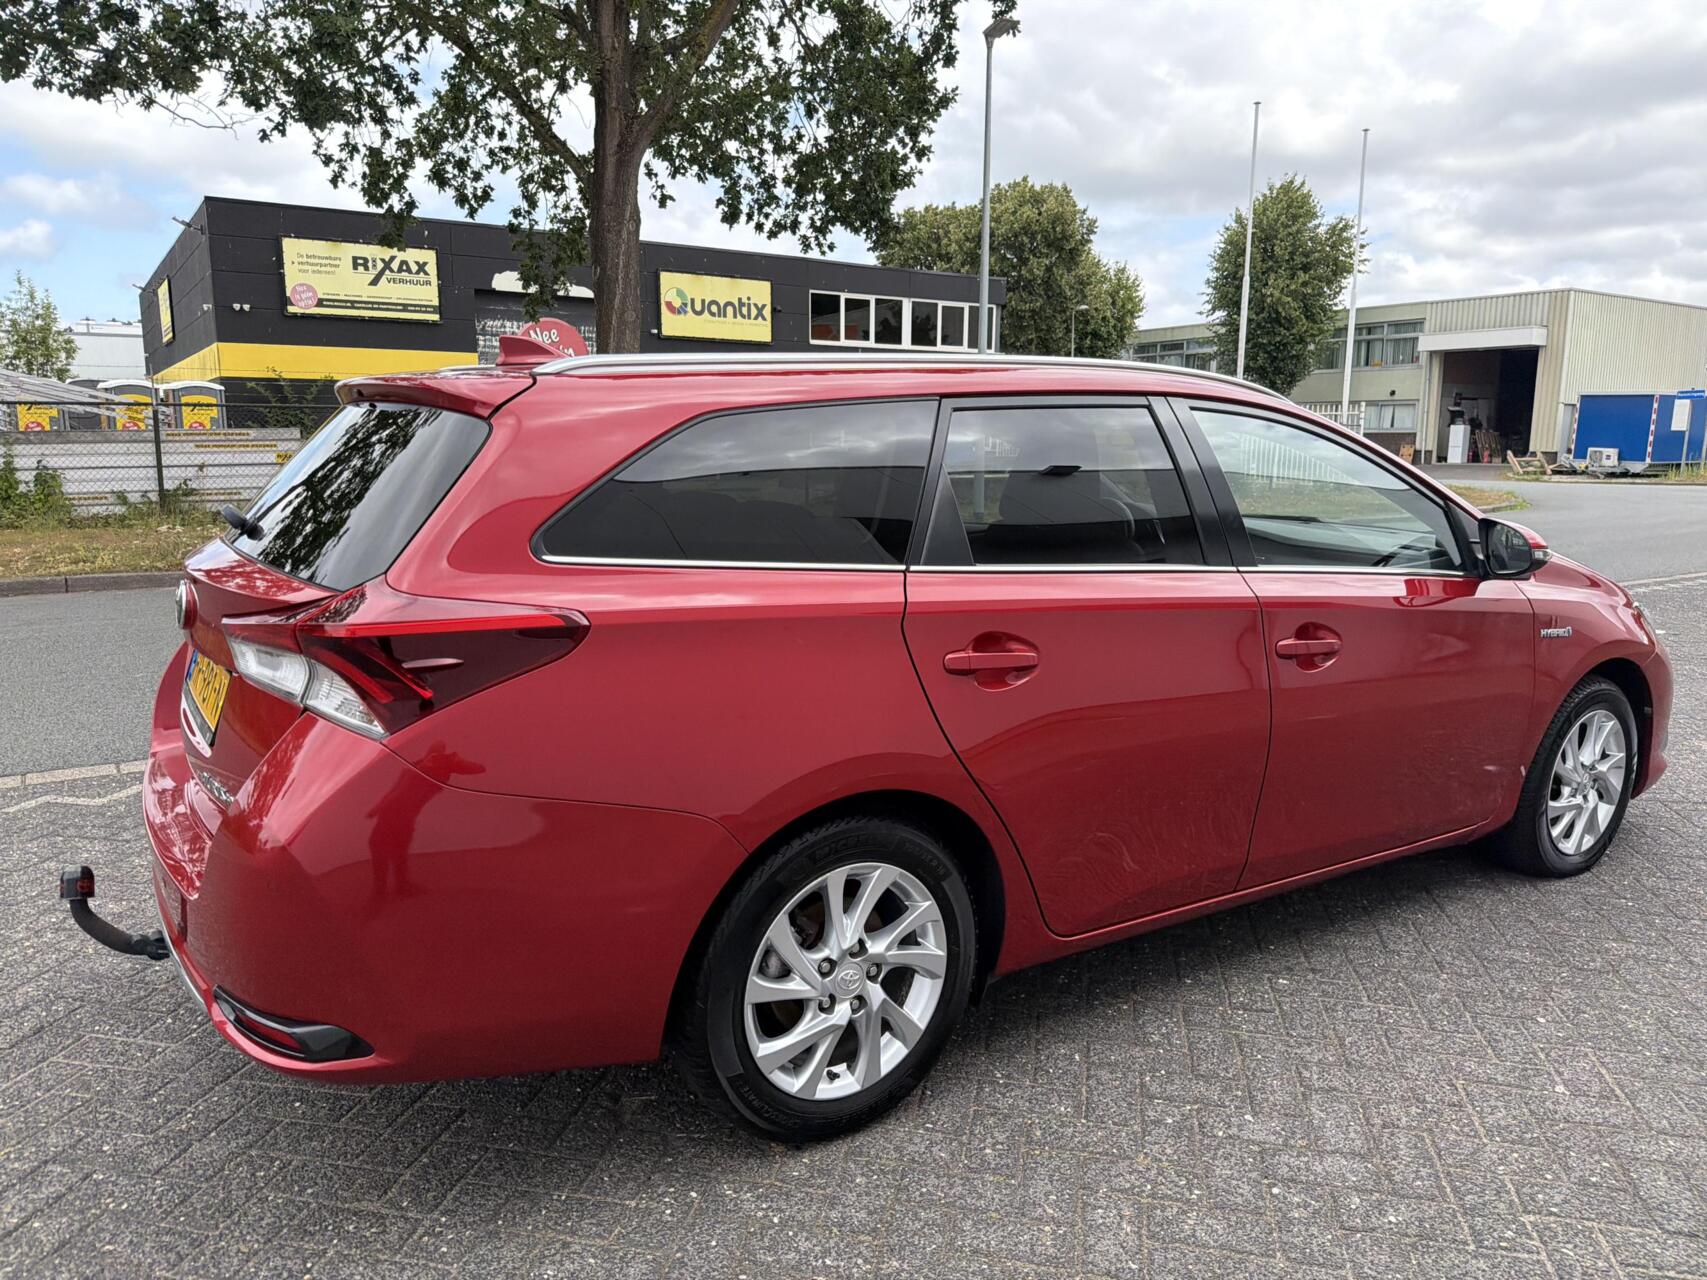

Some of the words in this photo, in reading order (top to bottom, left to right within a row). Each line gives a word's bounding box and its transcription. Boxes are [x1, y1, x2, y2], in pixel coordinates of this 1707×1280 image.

[386, 277, 432, 287] VERHUUR
[529, 327, 560, 344] Nee
[1540, 628, 1568, 638] HYBRID
